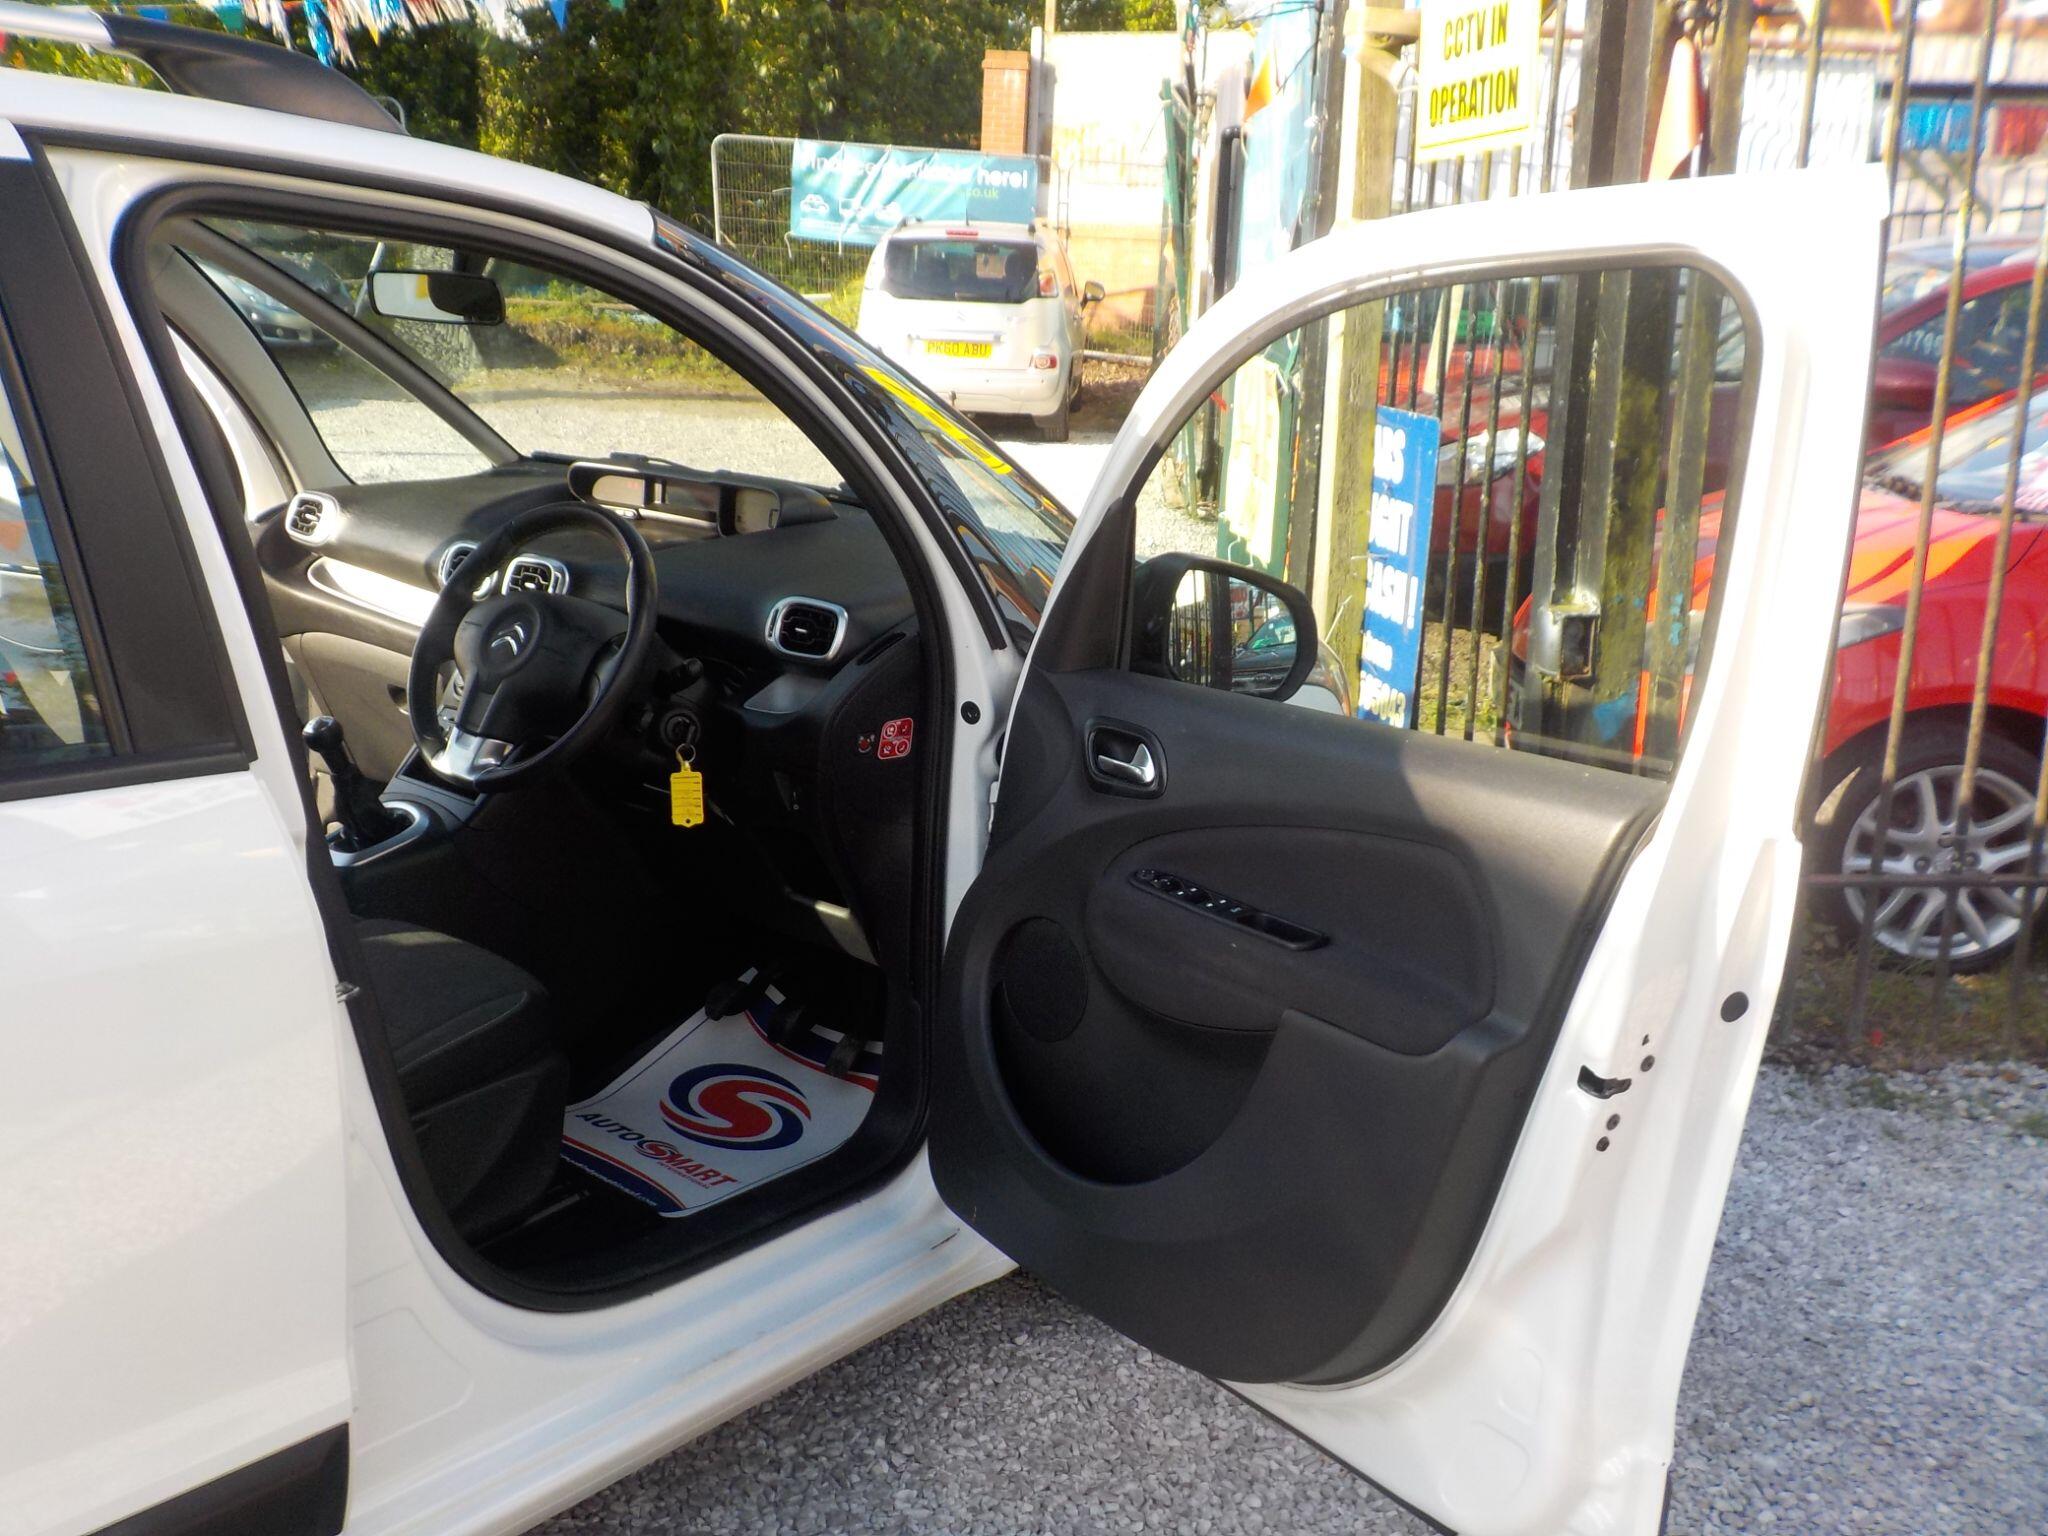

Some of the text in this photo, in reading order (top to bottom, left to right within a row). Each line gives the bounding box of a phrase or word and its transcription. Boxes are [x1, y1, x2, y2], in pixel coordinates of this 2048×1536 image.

[1444, 2, 1508, 60] CCTV IN
[1430, 67, 1519, 127] OPERATION
[963, 342, 988, 357] ABU
